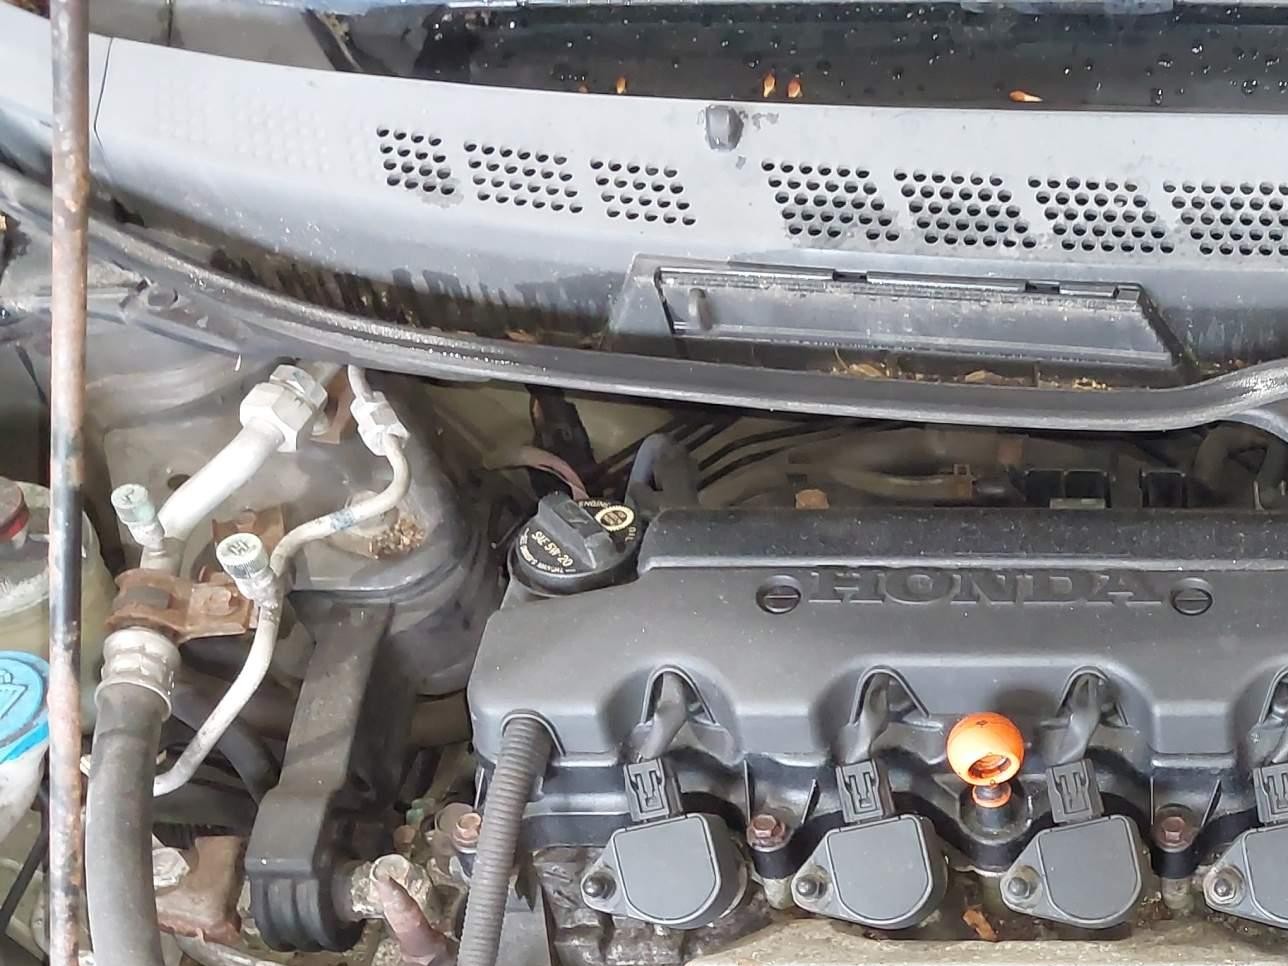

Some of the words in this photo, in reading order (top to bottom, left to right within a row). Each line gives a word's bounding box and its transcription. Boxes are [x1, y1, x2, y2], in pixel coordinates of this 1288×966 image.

[531, 530, 551, 547] SAE
[544, 542, 574, 567] 5W-20
[808, 568, 1163, 605] HONDA
